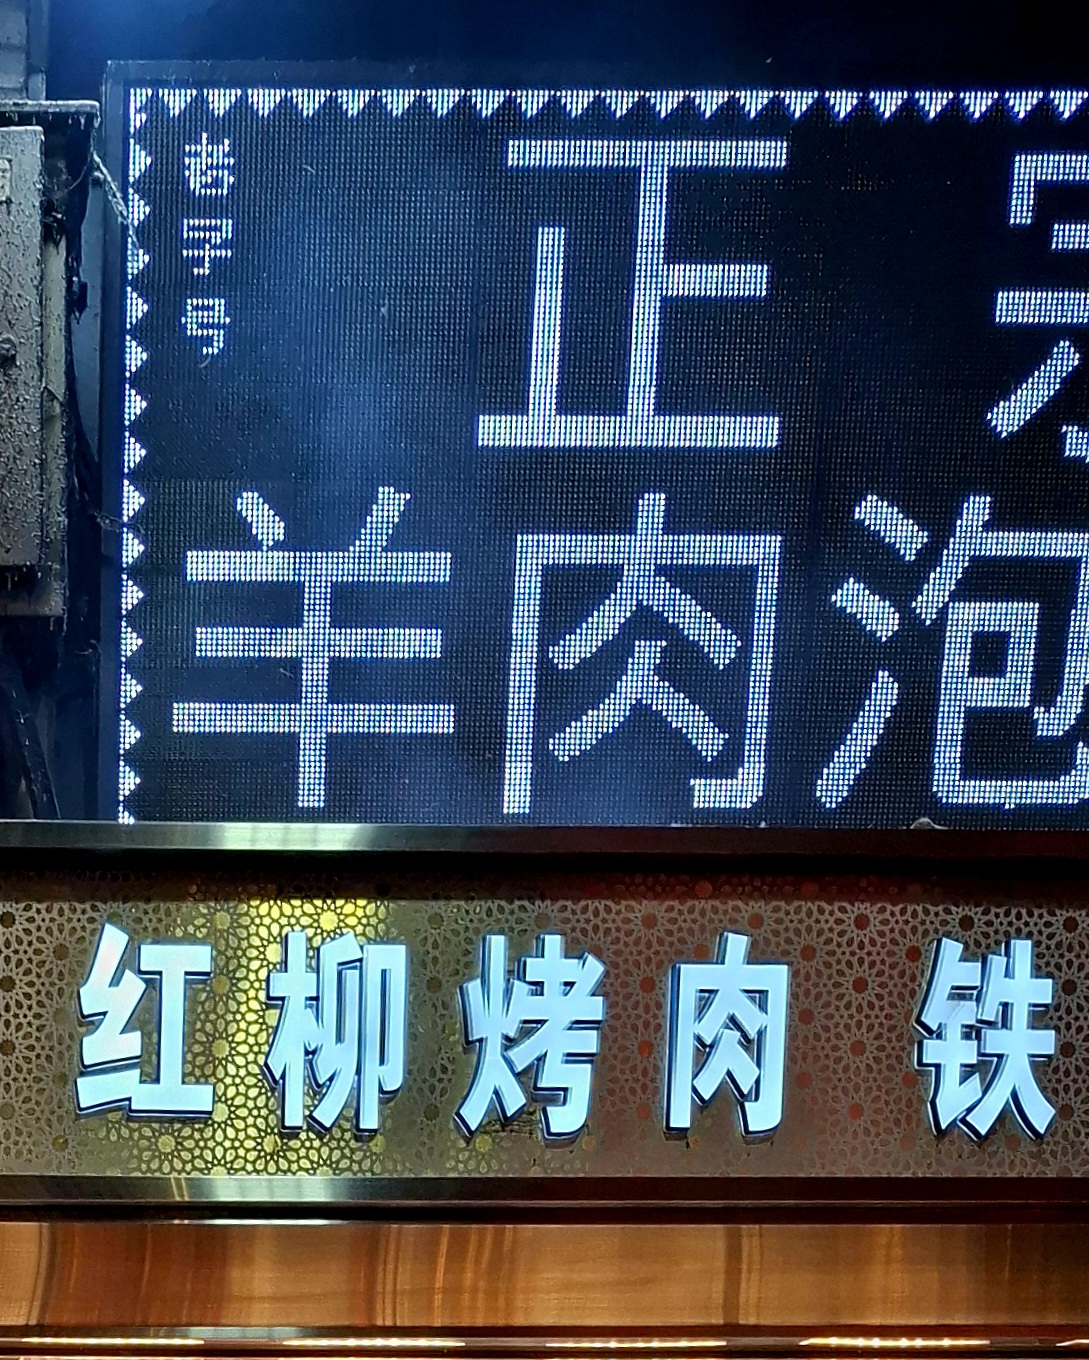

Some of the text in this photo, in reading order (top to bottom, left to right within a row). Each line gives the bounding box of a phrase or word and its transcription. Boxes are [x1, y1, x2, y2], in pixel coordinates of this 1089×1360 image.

[171, 485, 1089, 814] 羊肉泡
[76, 922, 1057, 1138] 红柳烤肉 铁
